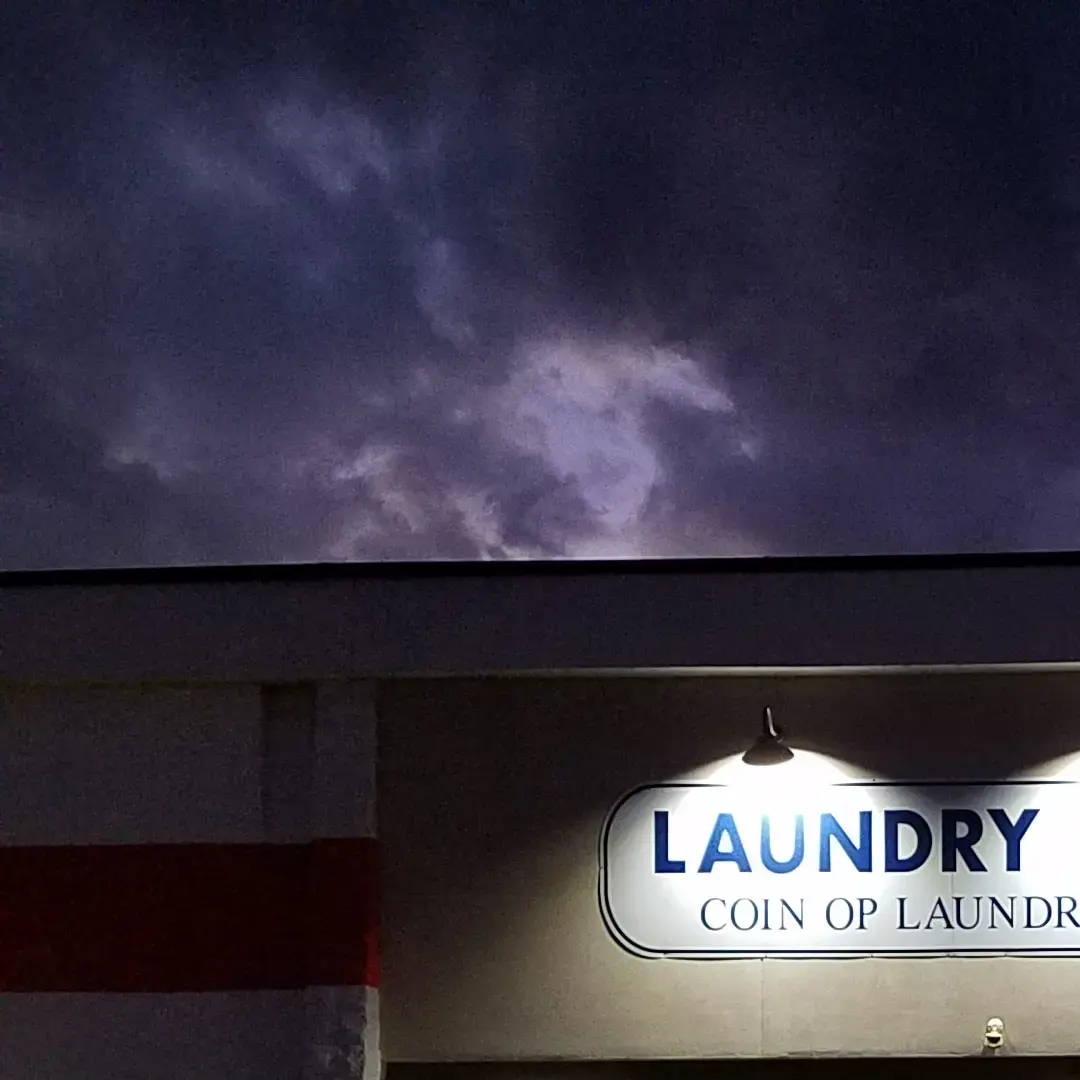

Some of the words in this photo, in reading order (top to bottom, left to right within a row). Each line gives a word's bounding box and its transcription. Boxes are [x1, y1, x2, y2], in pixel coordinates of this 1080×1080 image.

[654, 809, 1040, 874] LAUNDRY
[700, 897, 805, 931] COIN
[825, 897, 878, 931] OP
